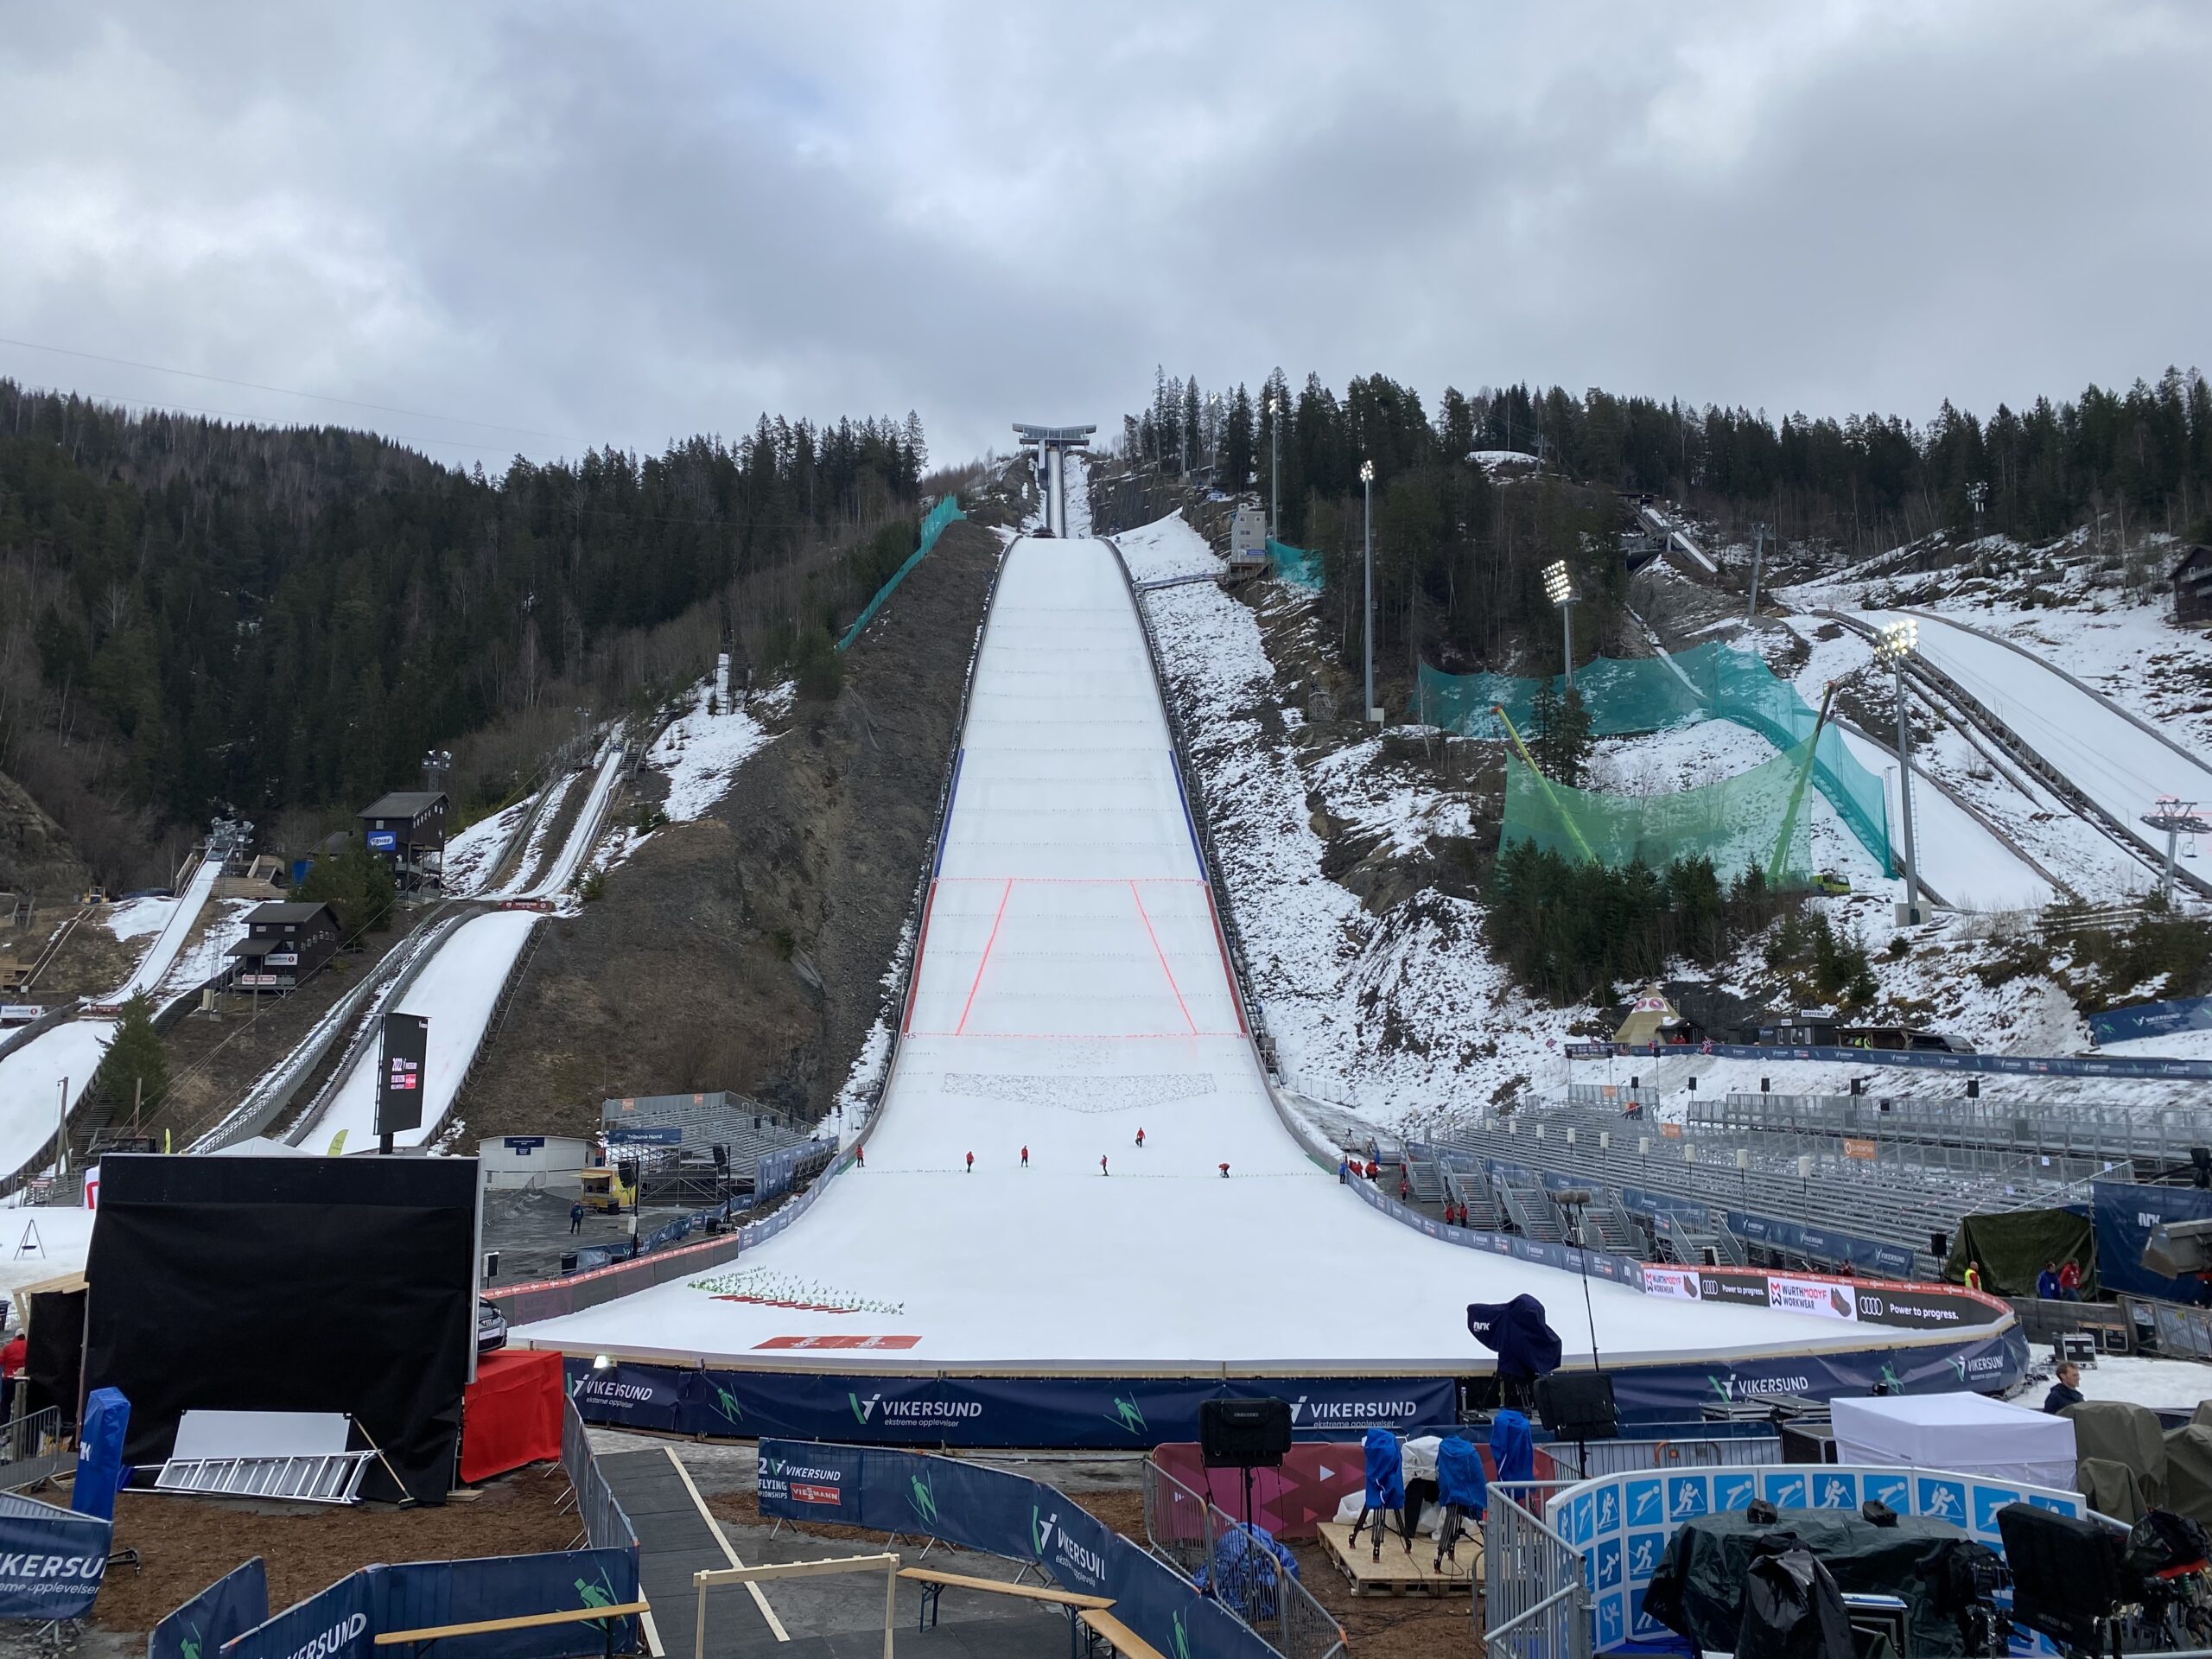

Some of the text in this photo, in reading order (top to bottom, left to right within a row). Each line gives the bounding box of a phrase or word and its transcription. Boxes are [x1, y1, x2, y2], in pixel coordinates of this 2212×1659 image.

[1783, 1298, 1815, 1310] WORKWEAR
[1890, 1303, 1960, 1320] Power to progress.
[1738, 1376, 1808, 1394] VIKERSUND
[882, 1402, 982, 1417] VIKERSUND
[1311, 1401, 1417, 1418] VIKERSUND
[786, 1465, 841, 1481] VIKERSUND
[758, 1479, 787, 1491] FLYING
[792, 1487, 838, 1500] VIESSMANN
[0, 1553, 107, 1580] KERSU
[28, 1581, 102, 1595] opplevelser
